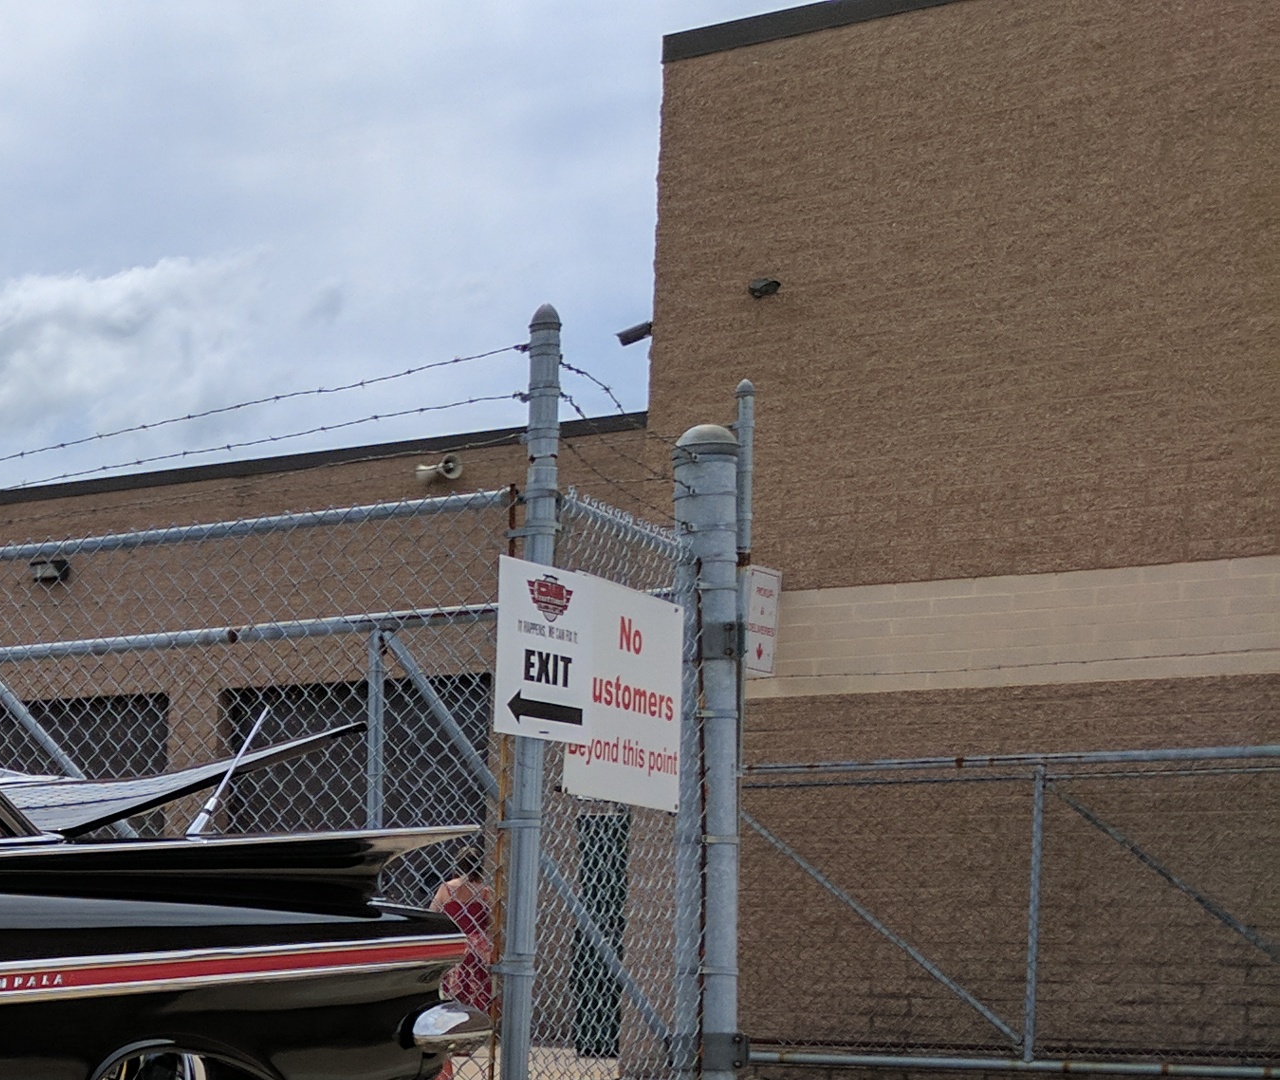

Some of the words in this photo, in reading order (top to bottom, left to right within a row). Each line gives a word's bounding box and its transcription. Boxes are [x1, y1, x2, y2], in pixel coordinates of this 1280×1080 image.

[619, 616, 643, 655] No
[524, 649, 572, 688] EXIT
[592, 675, 674, 722] ustomers
[623, 739, 645, 769] this
[648, 747, 678, 777] point
